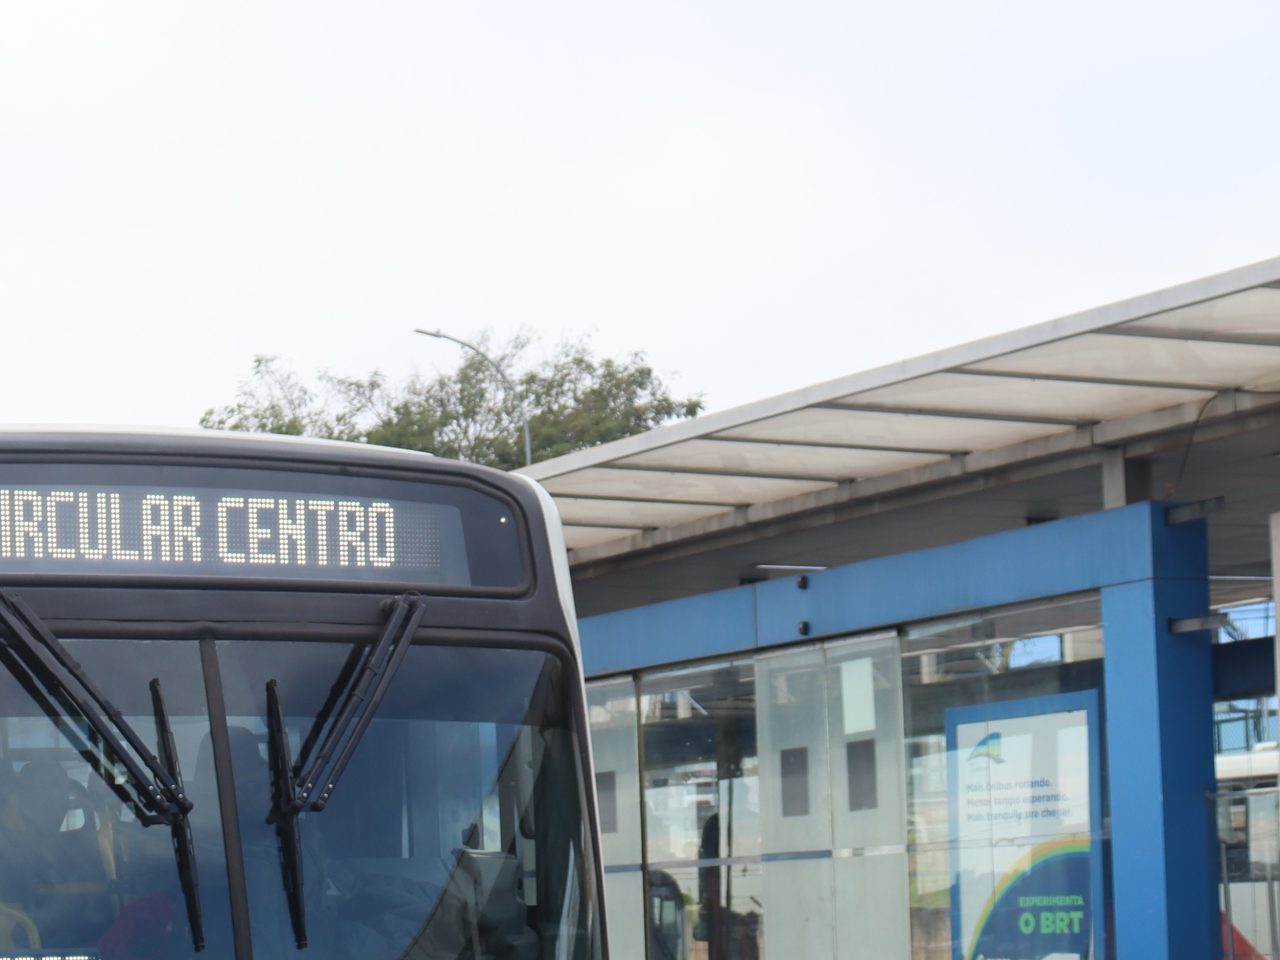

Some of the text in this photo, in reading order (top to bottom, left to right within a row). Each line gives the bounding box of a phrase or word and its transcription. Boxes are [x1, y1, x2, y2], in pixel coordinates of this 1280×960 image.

[218, 497, 395, 567] CENTRO
[1018, 895, 1085, 908] EXPERIMENTA
[1019, 911, 1084, 935] O BRT
